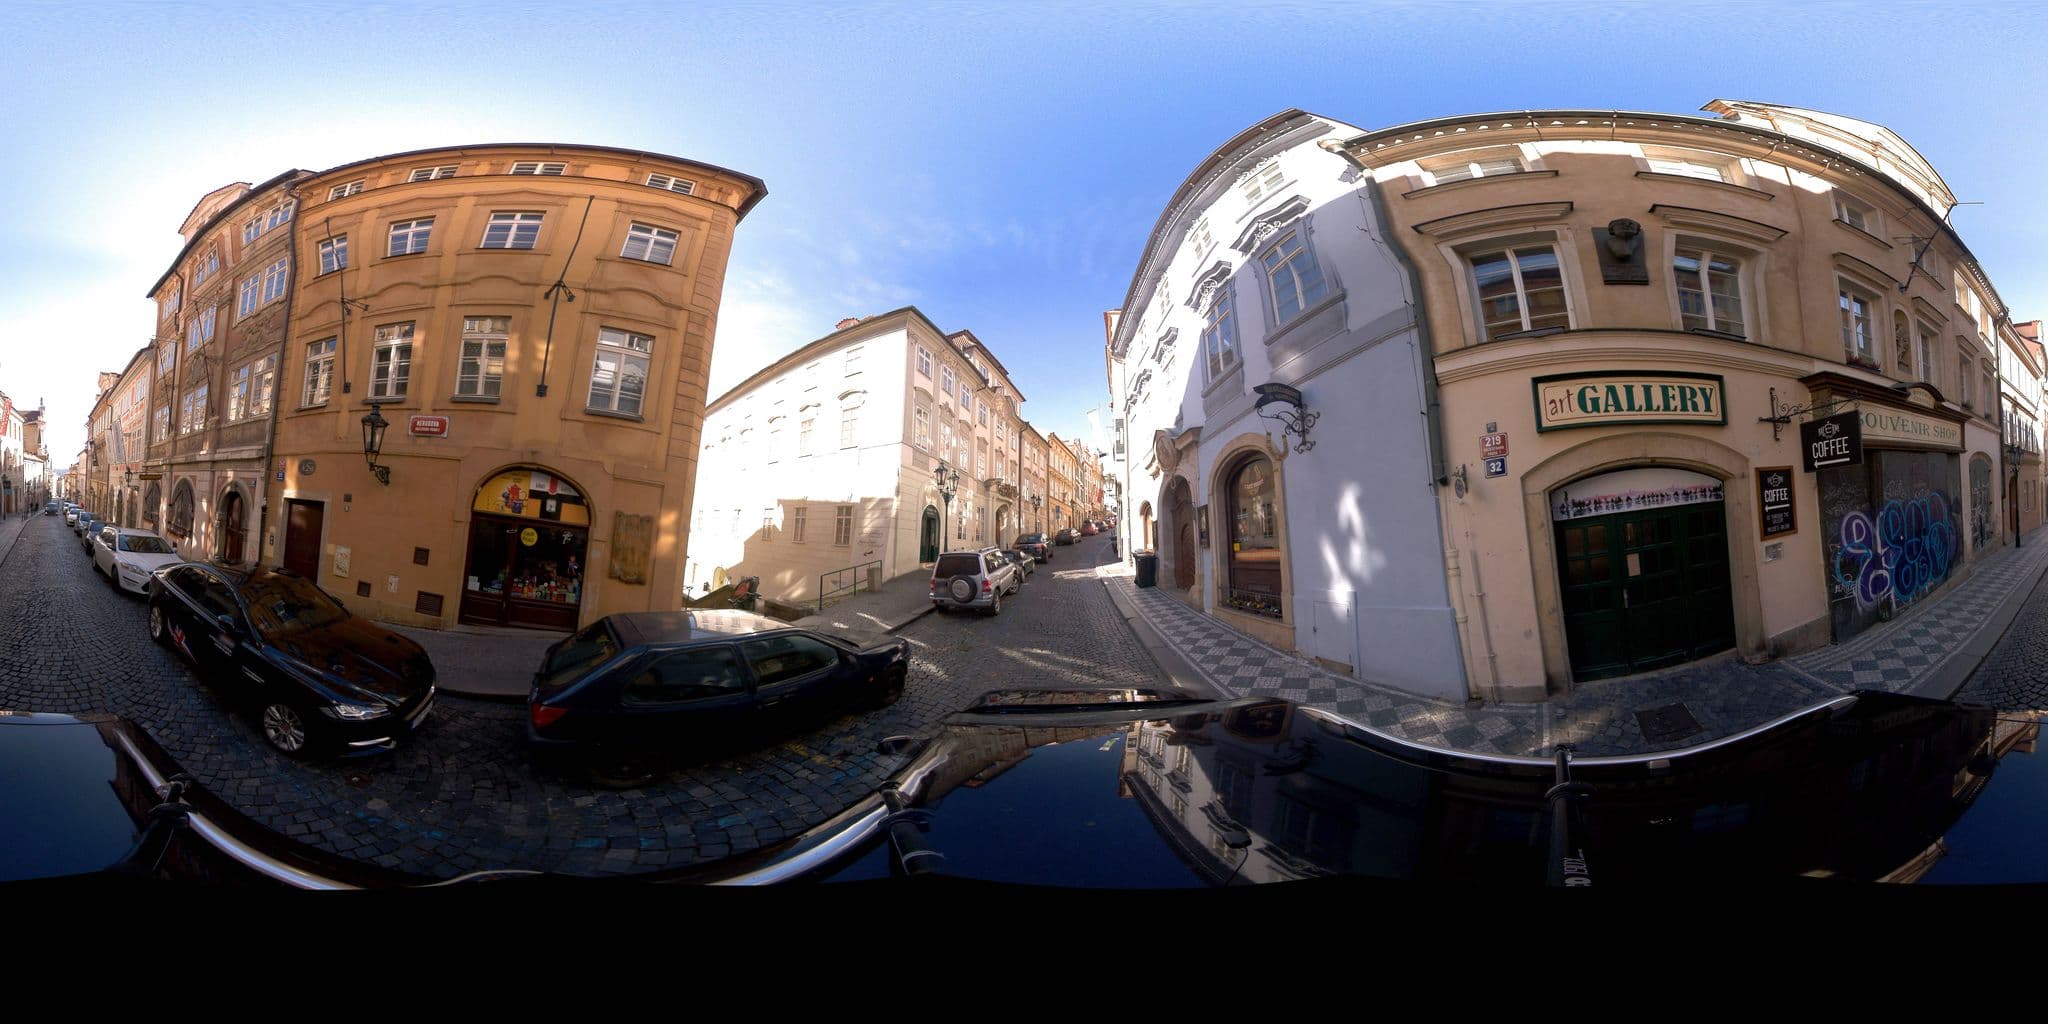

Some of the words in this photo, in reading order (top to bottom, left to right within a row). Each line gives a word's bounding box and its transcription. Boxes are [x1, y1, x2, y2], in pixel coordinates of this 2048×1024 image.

[1549, 388, 1574, 416] art
[1577, 384, 1714, 415] GALLERY
[1933, 424, 1957, 441] SHOP
[1485, 435, 1502, 447] 219
[1812, 436, 1850, 459] COFFEE
[1489, 461, 1503, 473] 32
[1764, 487, 1789, 503] COFFEE
